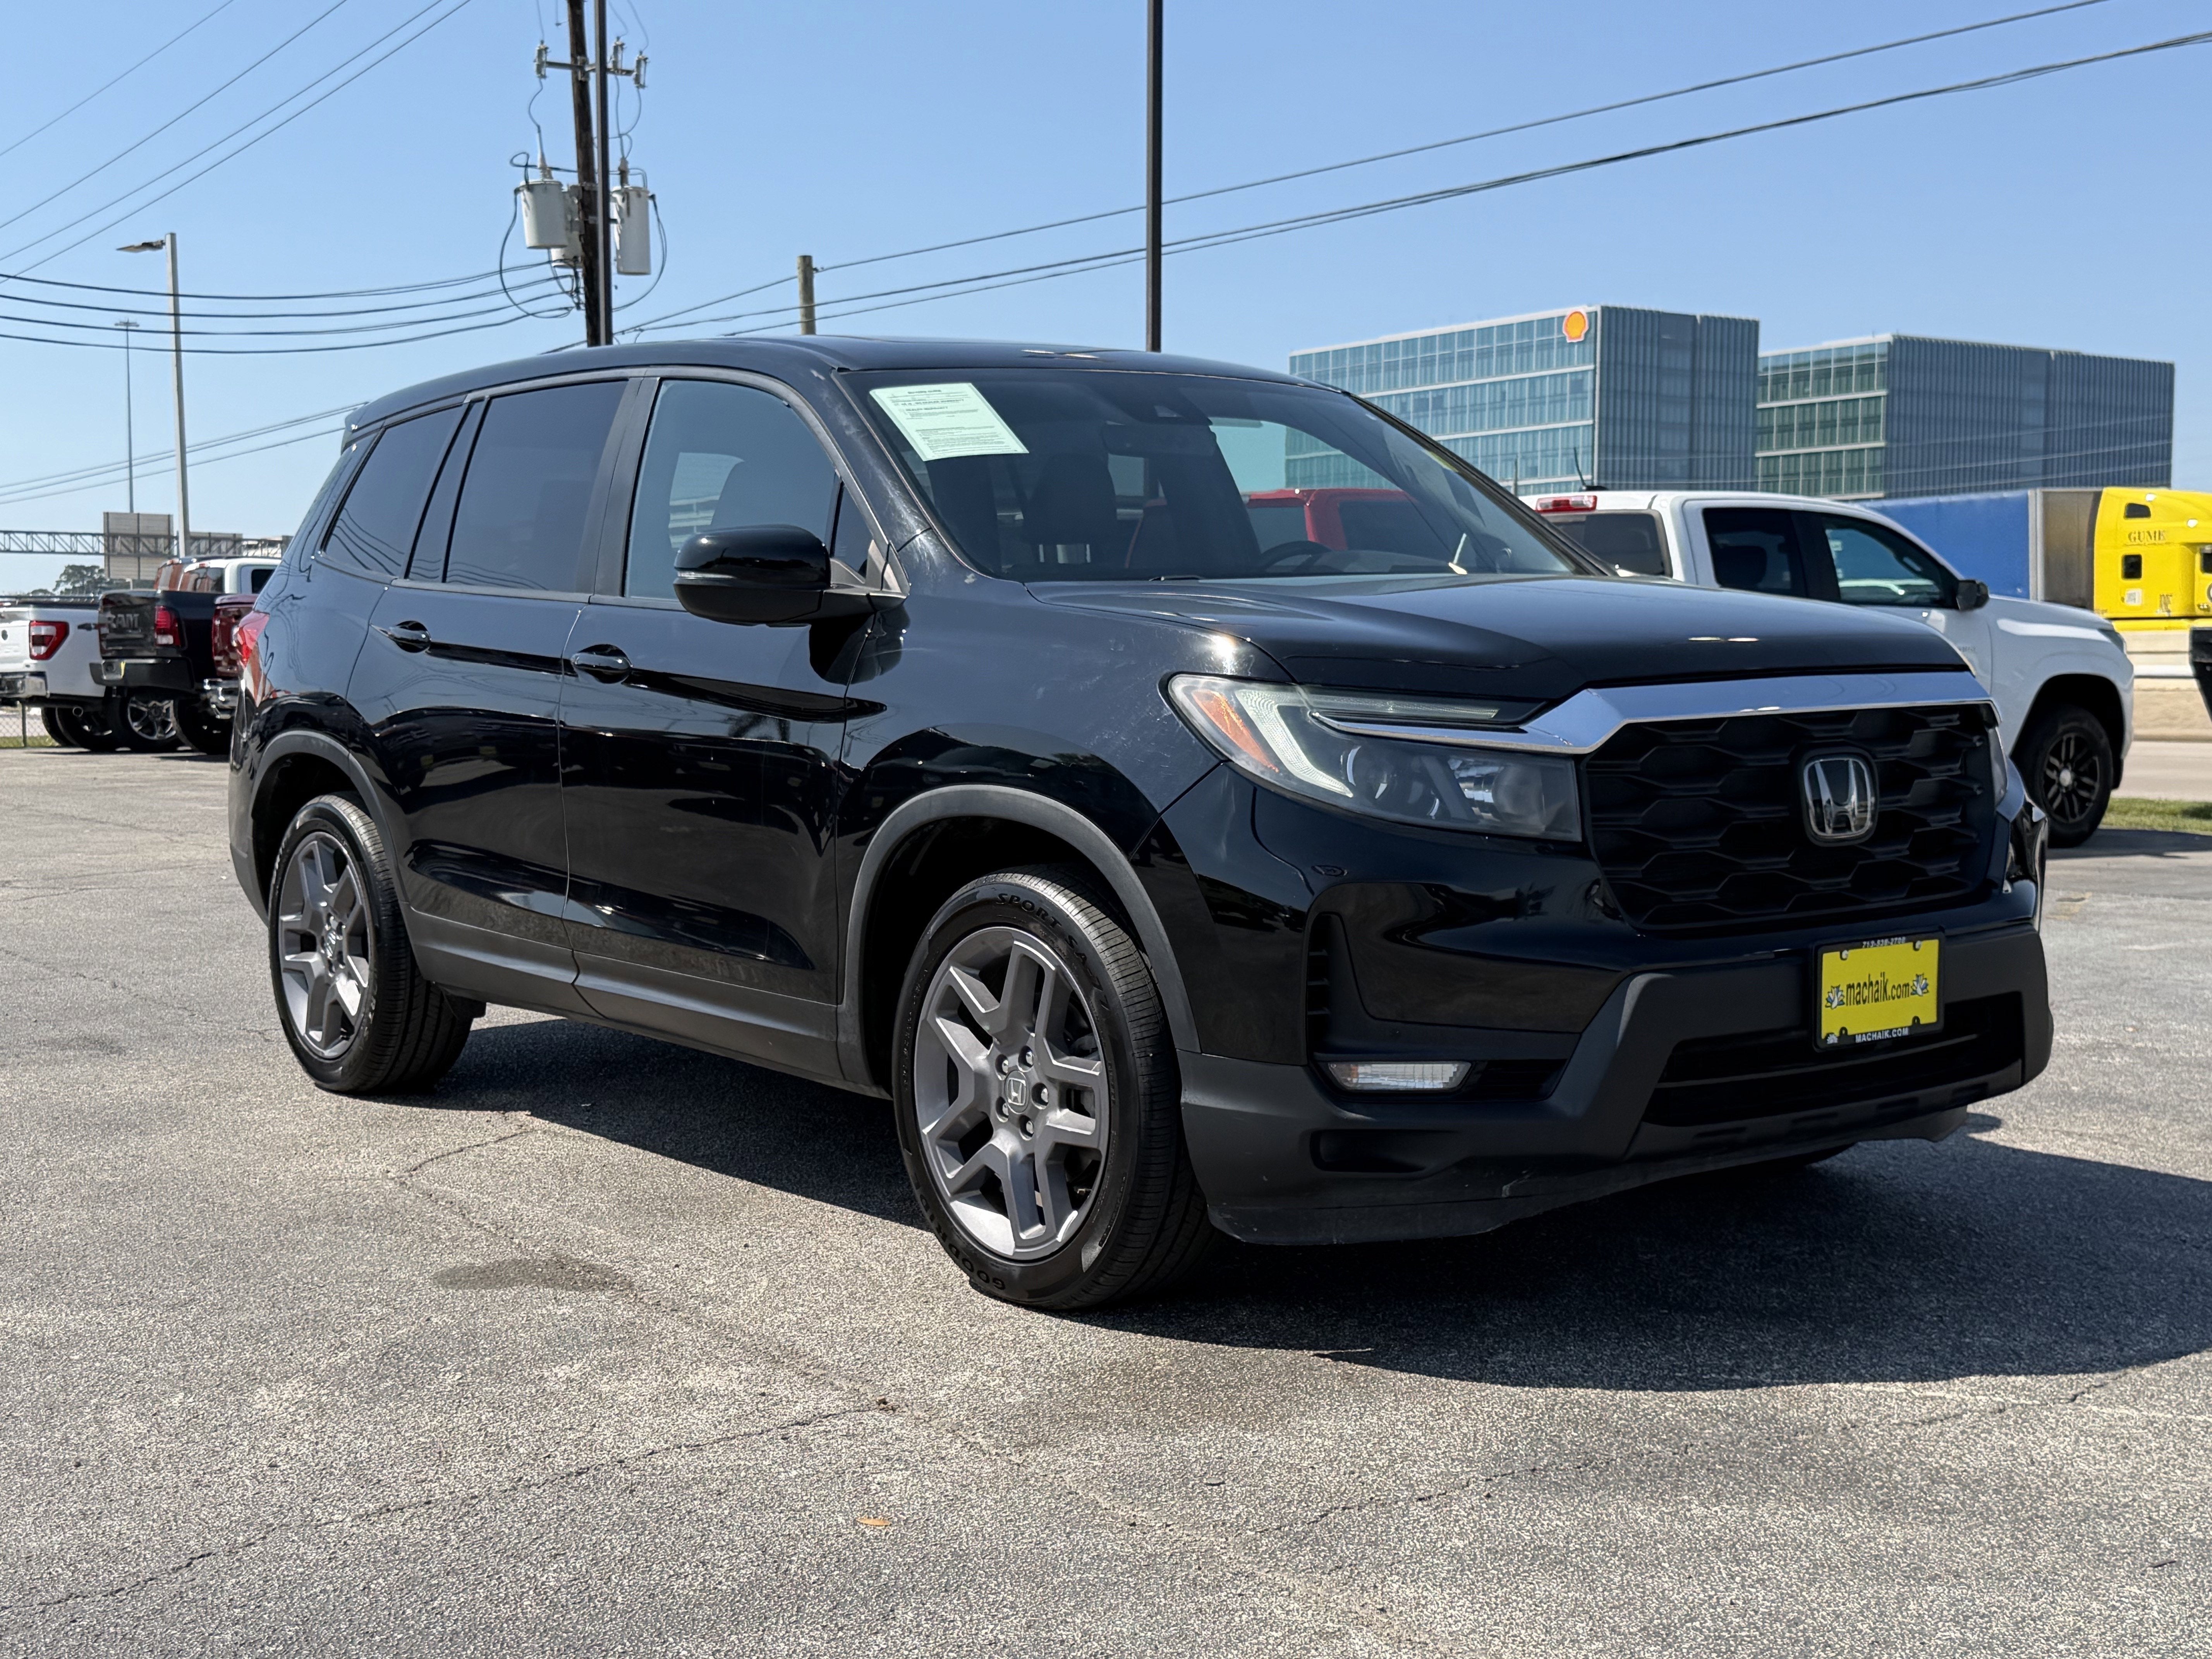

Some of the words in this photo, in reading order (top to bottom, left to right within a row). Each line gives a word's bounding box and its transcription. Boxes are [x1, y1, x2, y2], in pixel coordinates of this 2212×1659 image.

[996, 893, 1062, 928] SPORT
[1846, 972, 1909, 1006] machaik.com
[1855, 1028, 1908, 1043] MACHAIK.COM
